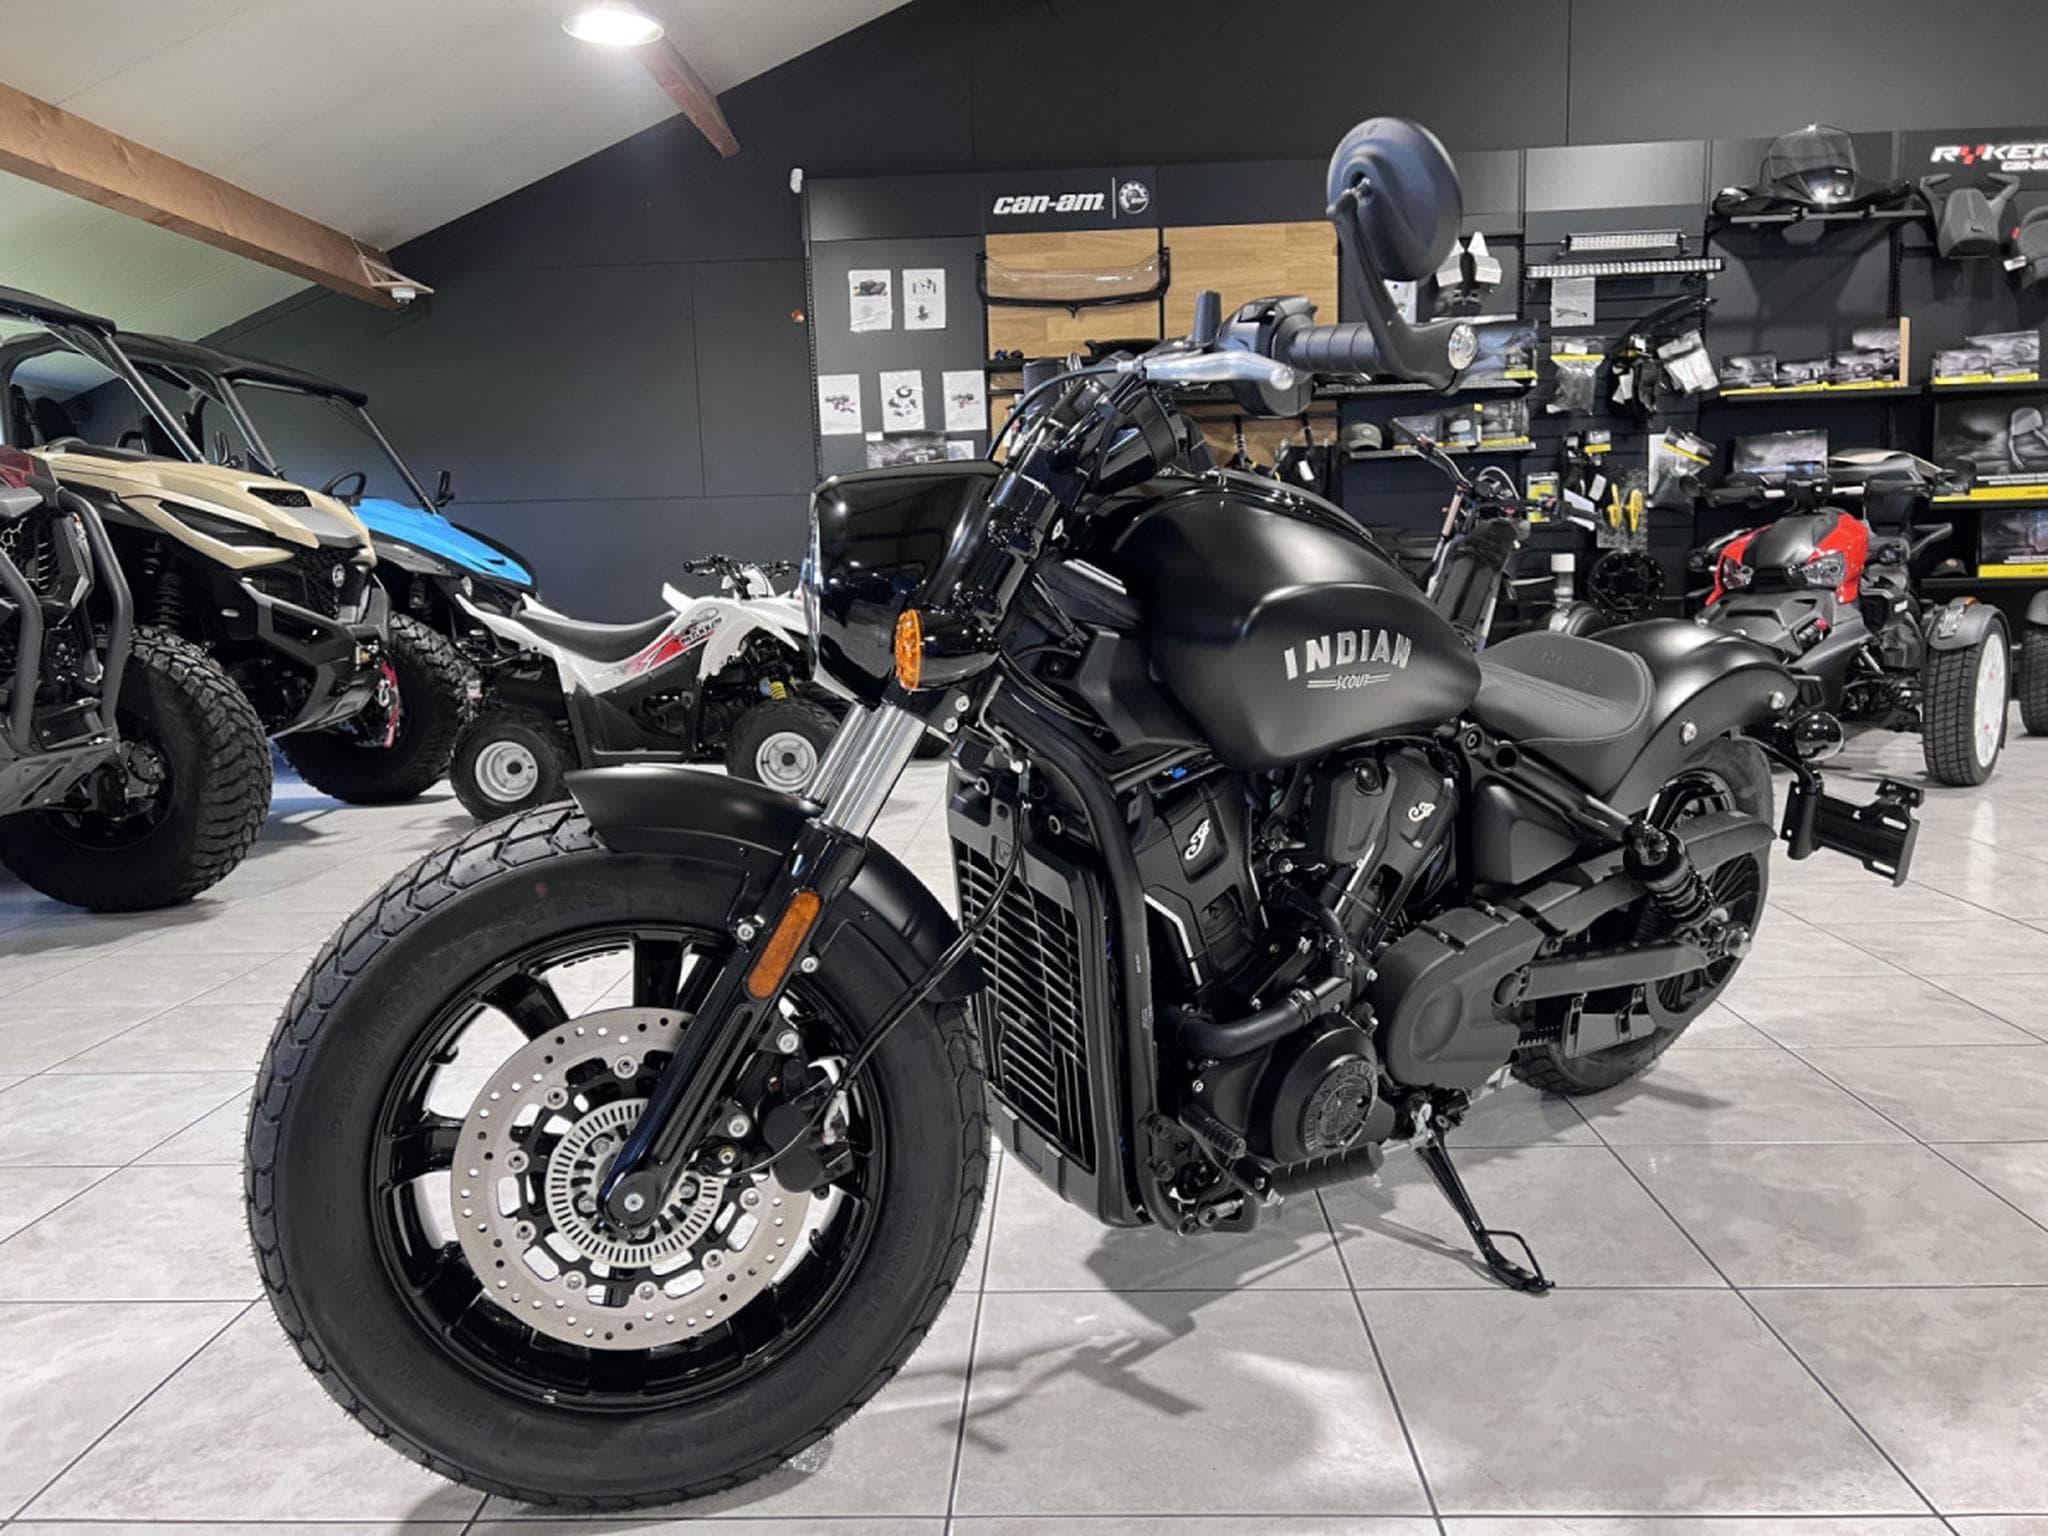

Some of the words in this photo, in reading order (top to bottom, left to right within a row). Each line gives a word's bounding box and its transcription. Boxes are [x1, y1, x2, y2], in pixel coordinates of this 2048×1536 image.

[993, 192, 1105, 215] can-am
[1284, 629, 1412, 680] INDIAN
[1335, 673, 1371, 690] SCOUT
